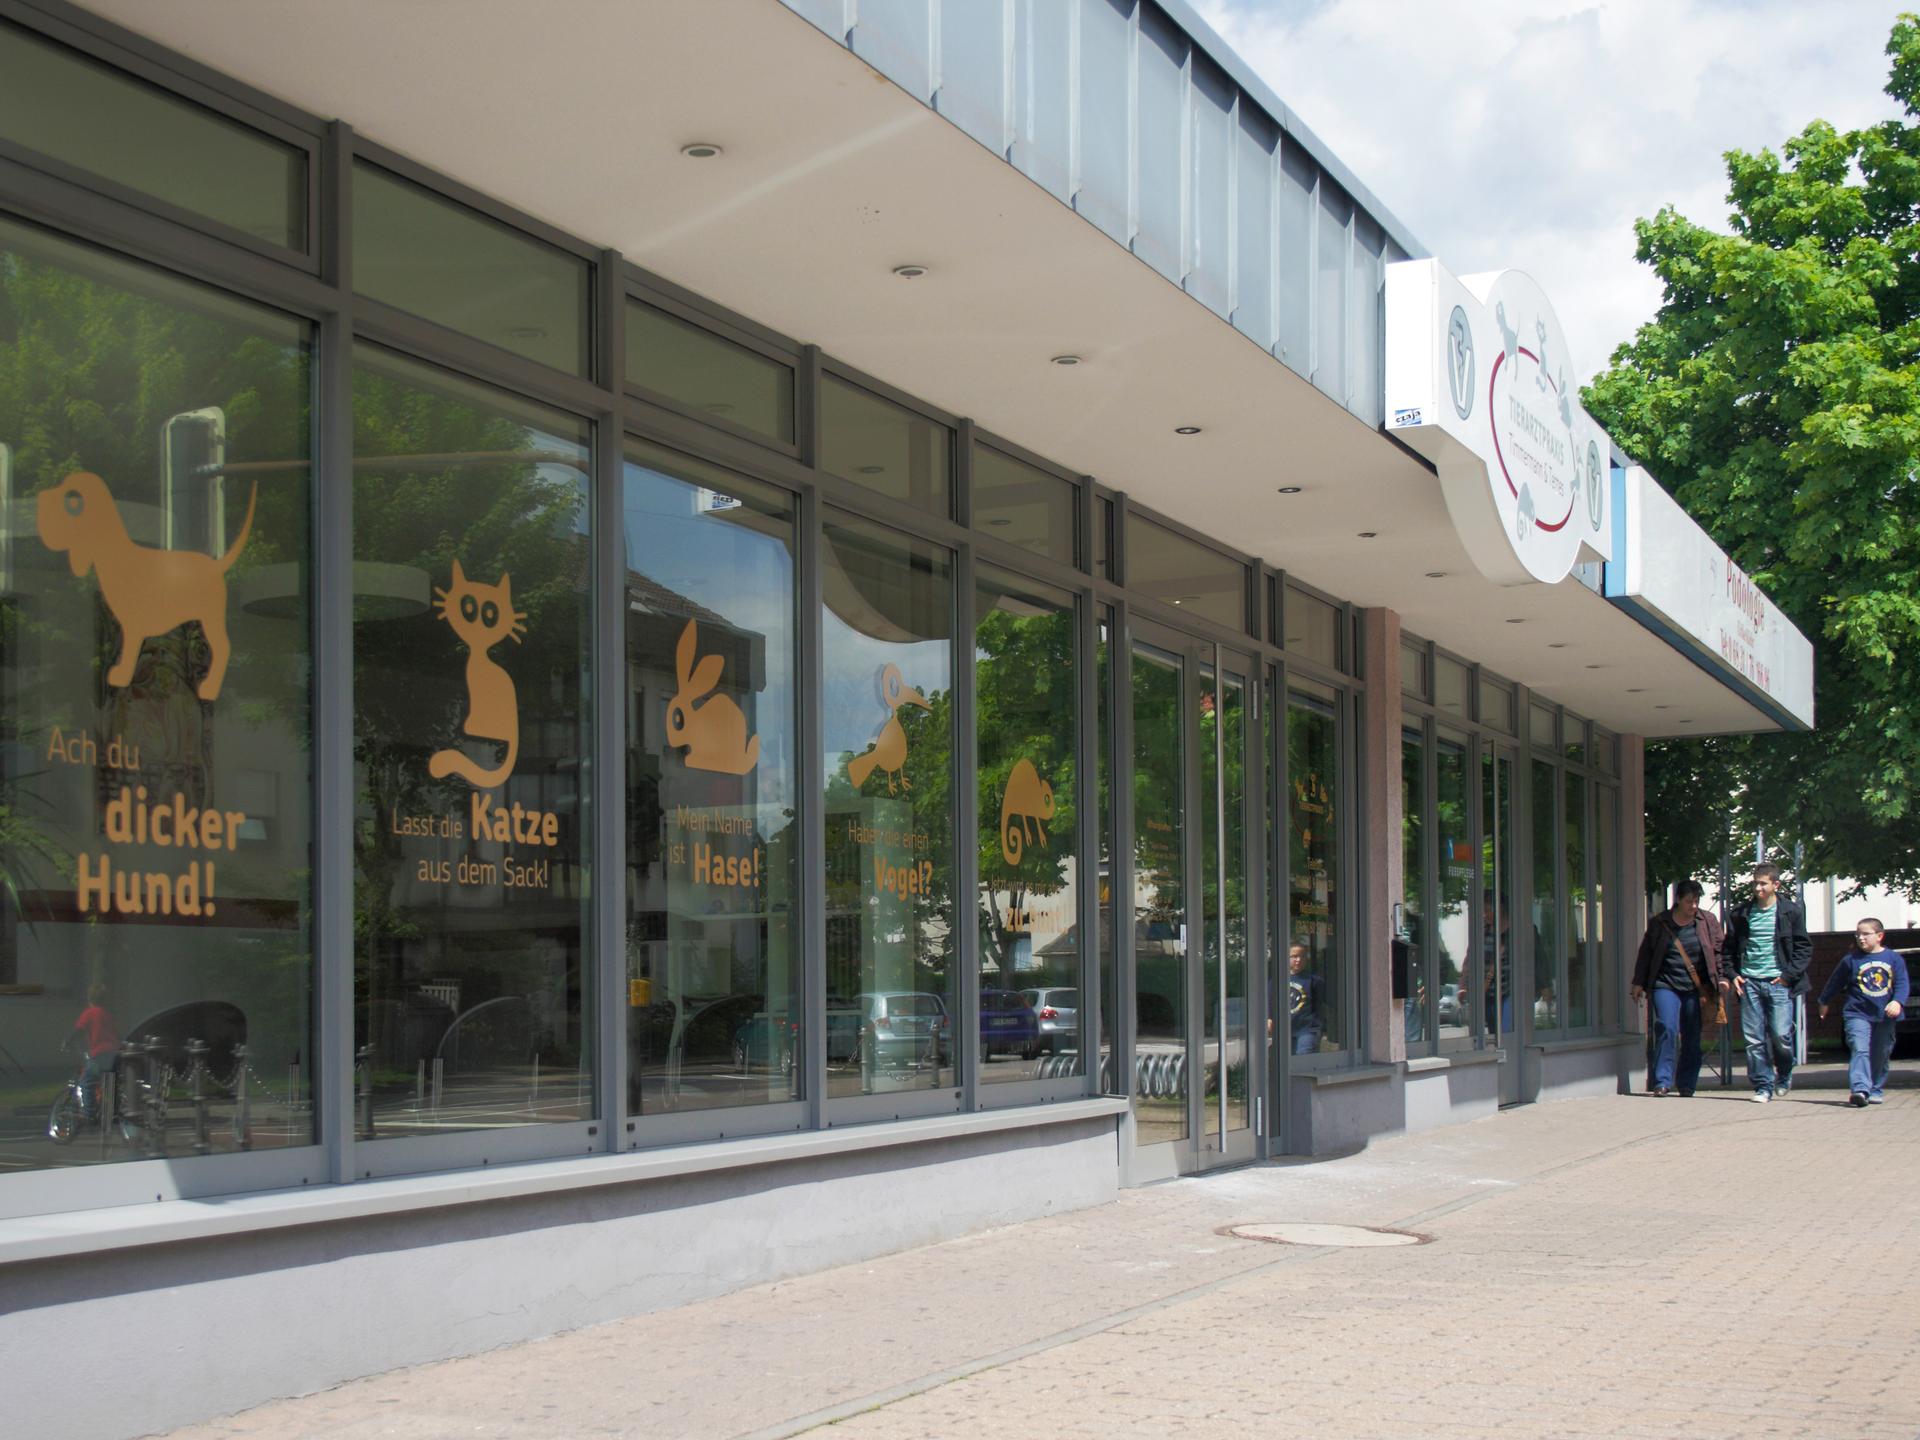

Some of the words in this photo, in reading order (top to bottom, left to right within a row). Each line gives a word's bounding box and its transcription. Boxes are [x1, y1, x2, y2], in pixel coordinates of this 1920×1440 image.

[1395, 411, 1421, 423] czaja
[1508, 395, 1564, 466] TIERARZTPRAXIS
[1726, 557, 1765, 634] Podologie
[48, 726, 97, 766] Ach
[106, 733, 141, 770] du
[105, 785, 246, 851] dicker
[392, 807, 436, 837] Lasst
[440, 814, 463, 839] die
[471, 791, 559, 847] Katze
[677, 804, 711, 832] Mein
[715, 807, 753, 837] Name
[77, 852, 216, 917] Hund!
[418, 858, 451, 882] aus
[458, 854, 497, 885] dem
[503, 856, 549, 888] Sack!
[668, 839, 686, 864] ist
[693, 841, 760, 888] Hase!
[874, 855, 933, 902] Vogel?
[1006, 907, 1024, 932] zu
